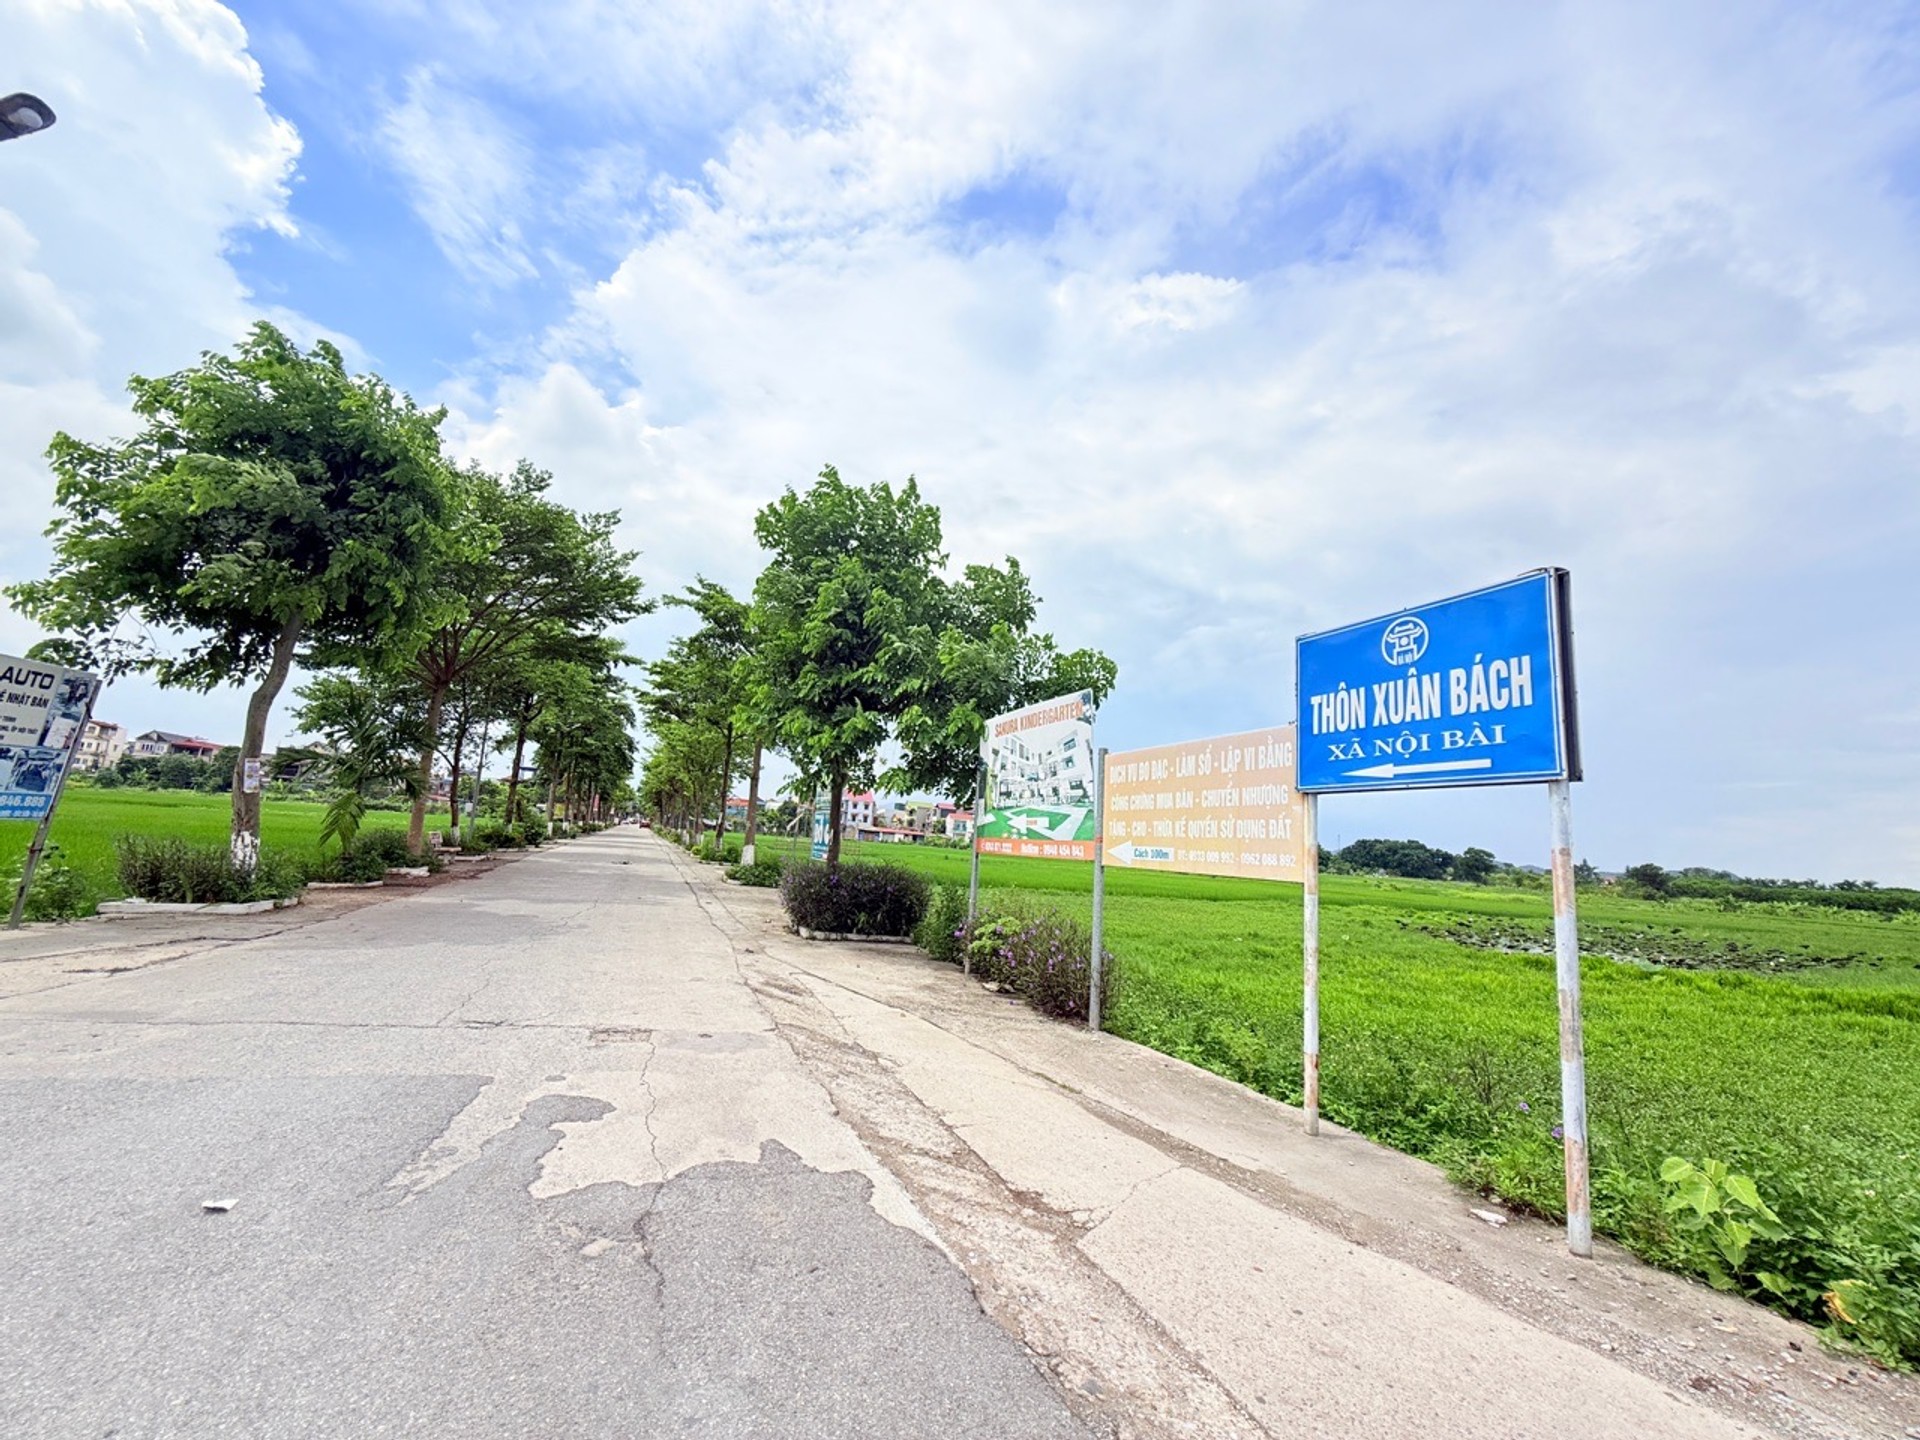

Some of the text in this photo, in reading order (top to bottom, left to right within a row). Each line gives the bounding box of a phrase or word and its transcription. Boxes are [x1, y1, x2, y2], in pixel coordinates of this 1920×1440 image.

[0, 666, 55, 689] AUTO
[1310, 653, 1533, 735] THÔN XUÂN BÁCH
[1019, 701, 1084, 732] KINDERGARTEN
[1328, 722, 1507, 761] XÃ NỘI BÀI
[1176, 752, 1196, 777] LÀM
[1221, 745, 1242, 778] LẬP
[1244, 747, 1256, 771] VI
[1242, 784, 1289, 810] NHƯỢNG
[1236, 819, 1266, 844] DỤNG
[1269, 812, 1292, 841] ĐẤT
[1134, 848, 1149, 859] Cách
